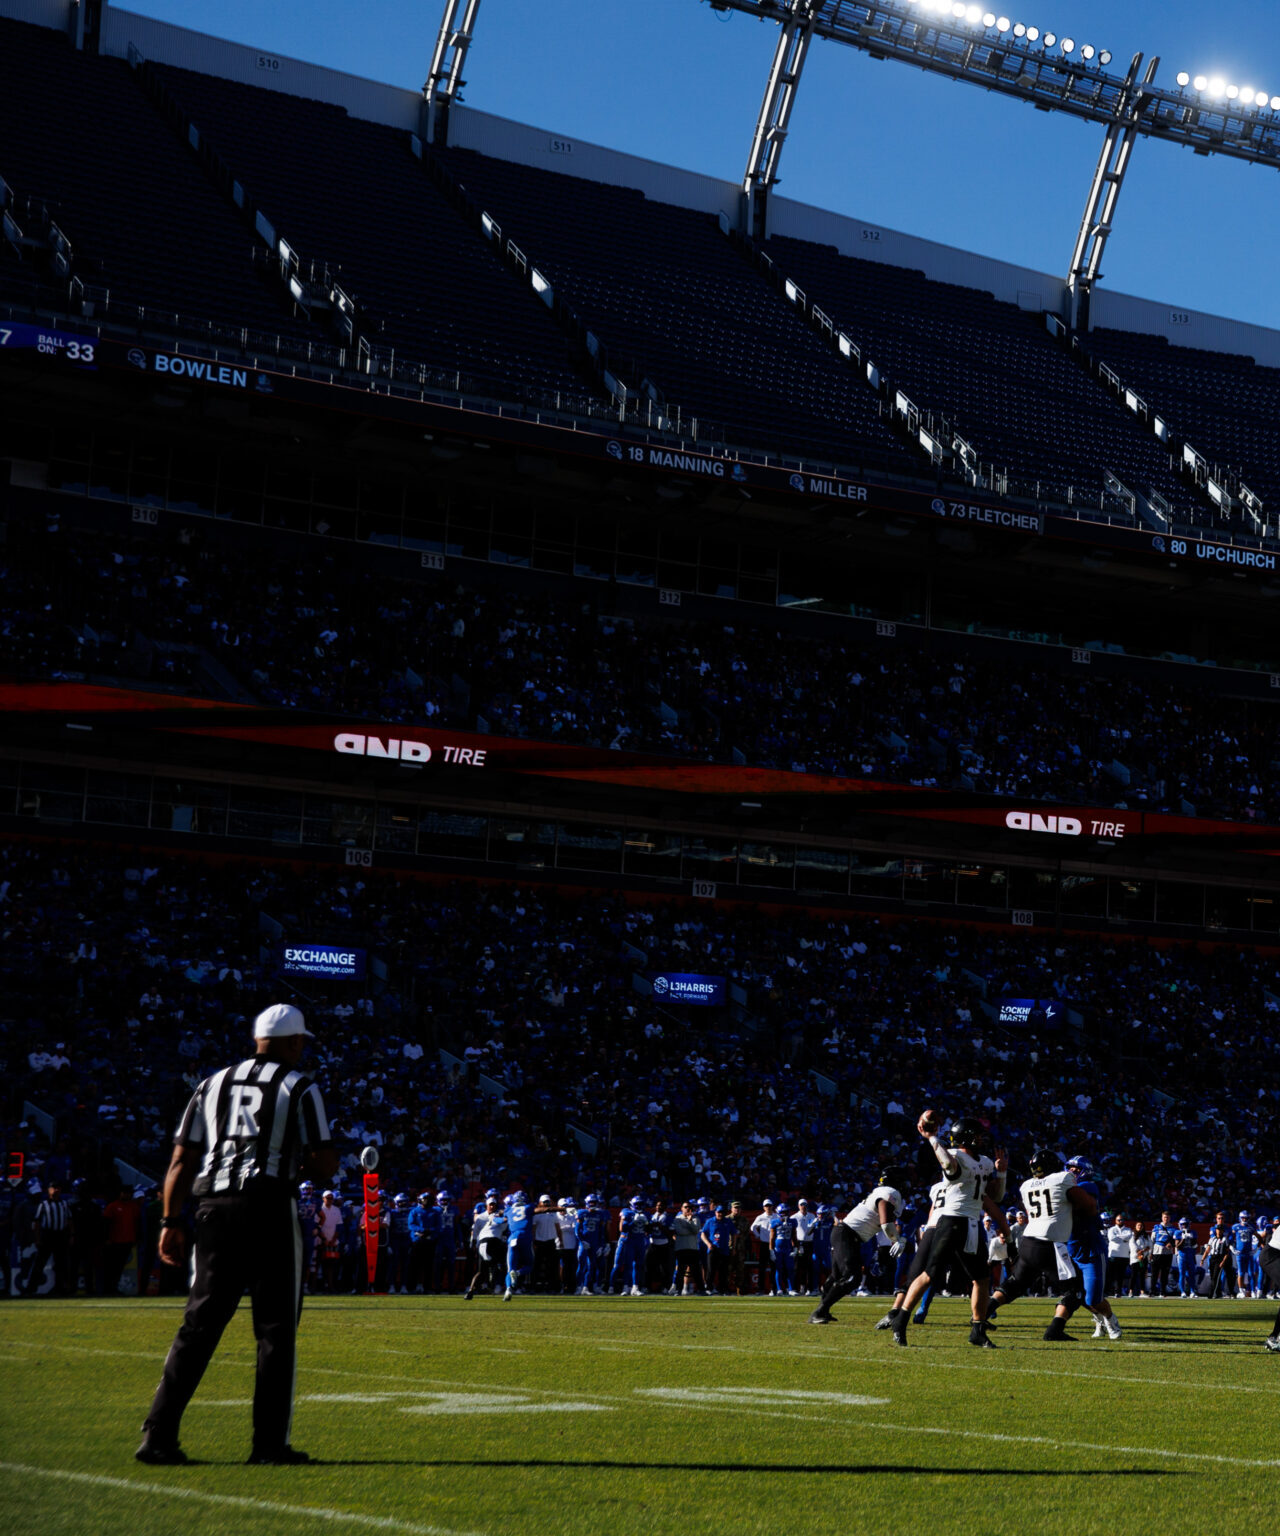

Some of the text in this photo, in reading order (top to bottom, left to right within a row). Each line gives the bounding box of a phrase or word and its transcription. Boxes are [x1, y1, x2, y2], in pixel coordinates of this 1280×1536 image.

[259, 57, 279, 70] 510
[553, 141, 571, 153] 511
[863, 230, 880, 241] 512
[1172, 313, 1189, 323] 513
[38, 334, 65, 348] BALL
[66, 341, 95, 362] 33
[155, 353, 248, 388] BOWLEN
[628, 447, 725, 477] 18 MANNING
[809, 478, 868, 501] MILLER
[134, 510, 157, 523] 310
[949, 502, 1040, 531] 73 FLETCHER
[422, 554, 443, 569] 311
[1171, 540, 1276, 569] 80 UPCHURCH
[443, 745, 487, 767] TIRE
[1091, 820, 1125, 838] TIRE
[348, 851, 370, 865] 106
[694, 883, 715, 897] 107
[1013, 911, 1032, 925] 108
[284, 948, 356, 966] EXCHANGE
[670, 981, 714, 993] L3HARRIS
[228, 1085, 263, 1136] R
[1028, 1188, 1054, 1218] 51
[512, 1205, 526, 1222] 3
